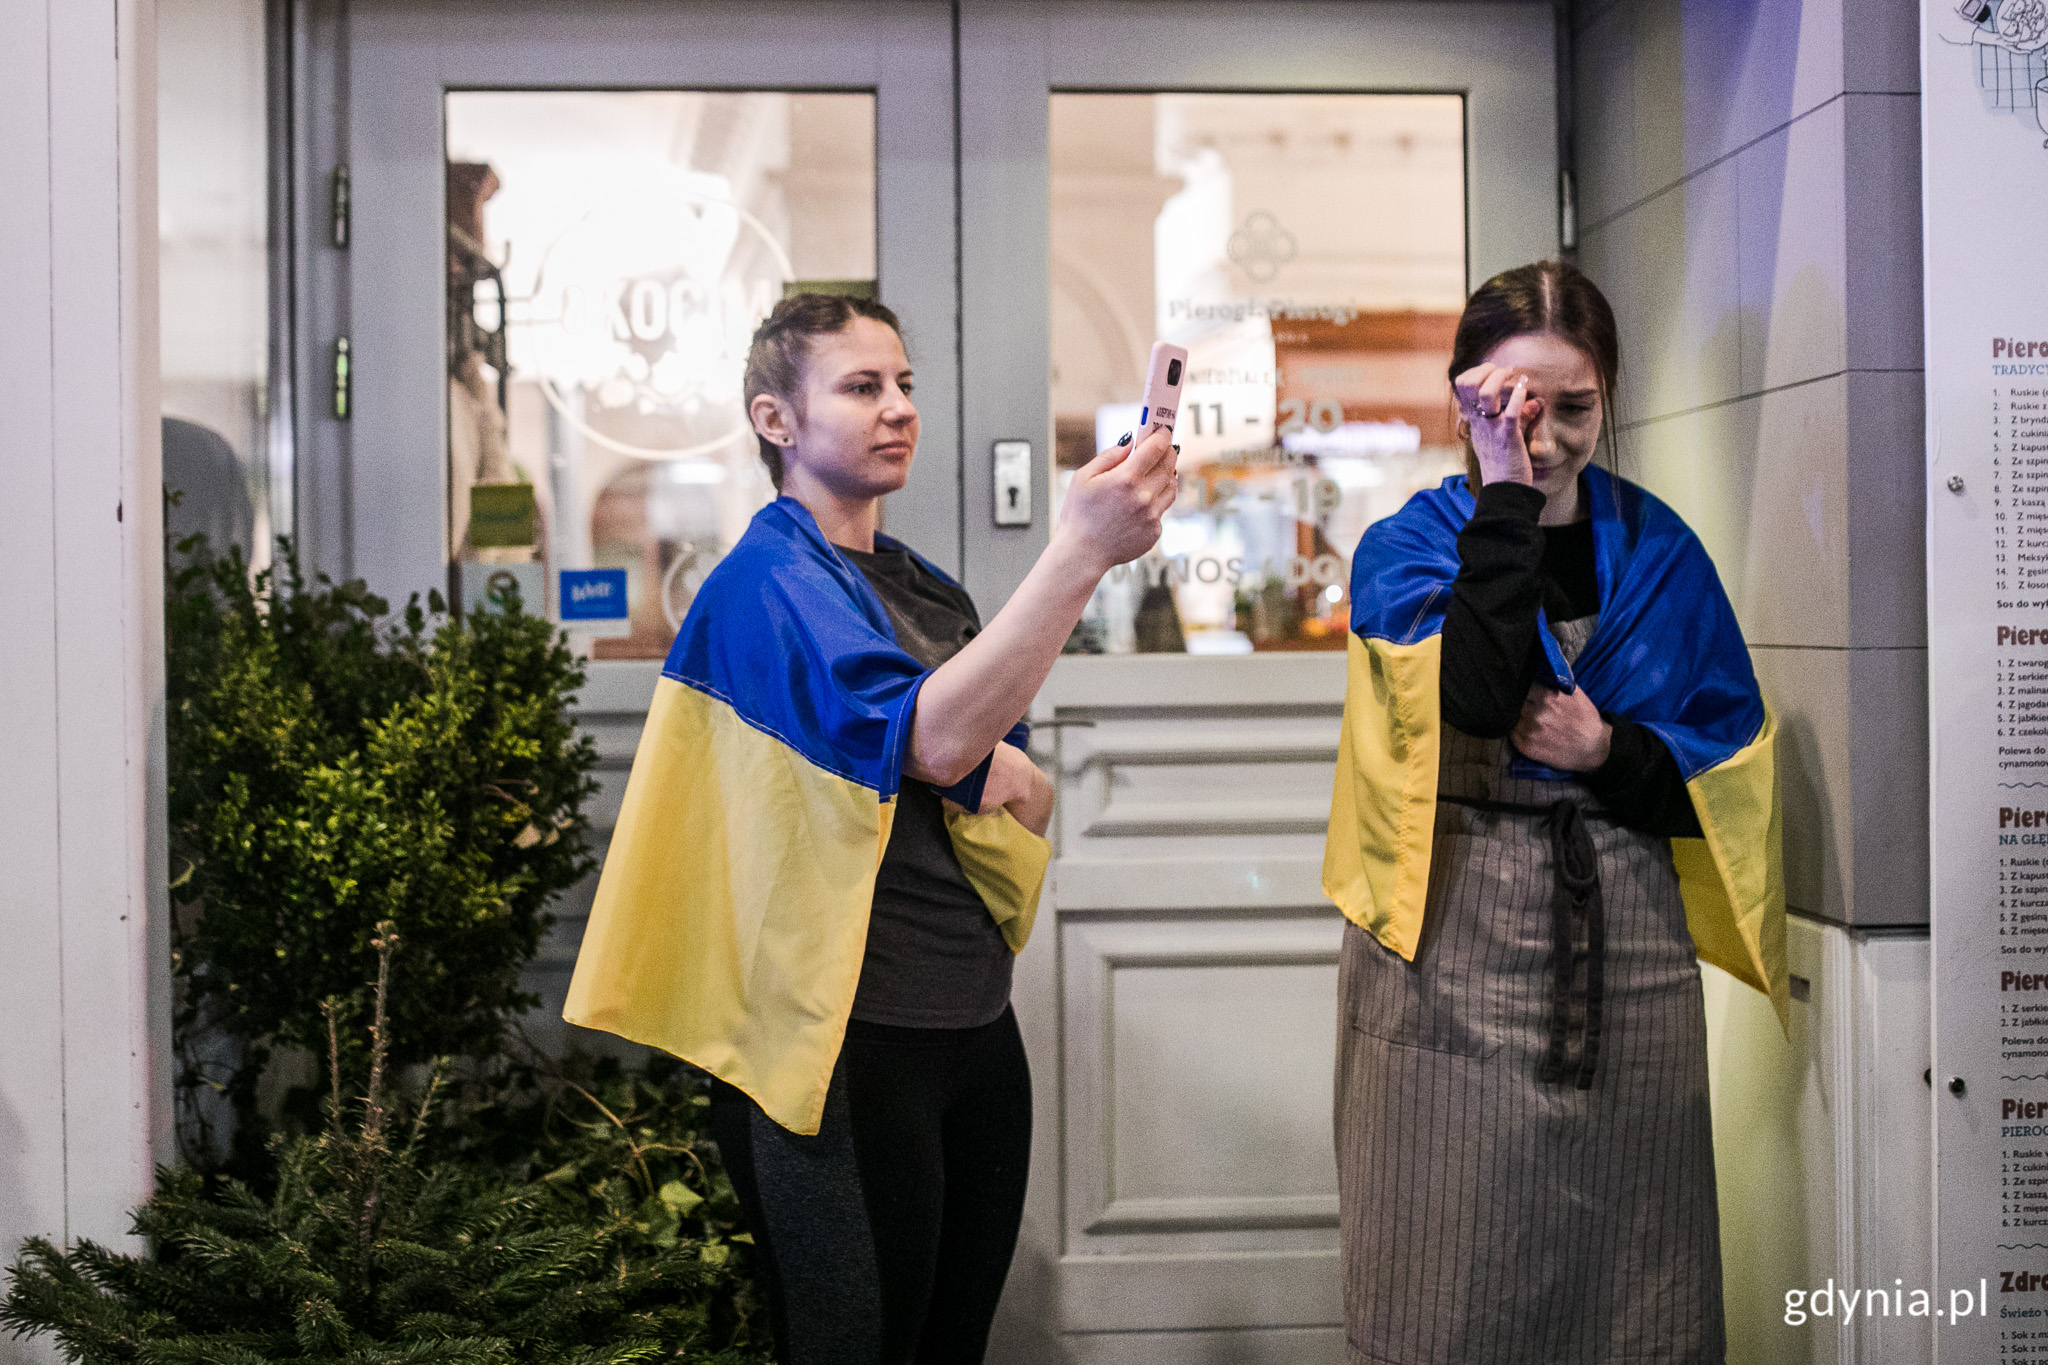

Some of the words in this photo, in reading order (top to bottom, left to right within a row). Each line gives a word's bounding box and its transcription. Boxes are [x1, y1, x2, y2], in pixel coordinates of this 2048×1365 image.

[1992, 364, 2048, 375] TRADYC
[2010, 387, 2040, 397] Ruskie
[2010, 401, 2040, 411] Ruskie
[1188, 403, 1225, 435] 11
[1277, 398, 1343, 435] 20
[2020, 415, 2048, 426] brynd
[2012, 457, 2023, 466] Ze
[2012, 470, 2023, 479] Ze
[2012, 484, 2024, 493] Ze
[1997, 600, 2014, 609] Sos
[2016, 600, 2030, 609] do
[2018, 673, 2048, 681] serkie
[2018, 686, 2048, 695] malina
[2018, 700, 2048, 711] jagoda
[2018, 714, 2048, 725] jabłkie
[1999, 746, 2032, 755] Polewa
[2034, 746, 2046, 754] do
[1999, 807, 2048, 828] Pier
[1999, 834, 2019, 846] NA
[2022, 833, 2048, 847] GŁĘ
[2010, 858, 2040, 867] Ruskie
[2010, 885, 2023, 894] Ze
[2001, 945, 2017, 954] Sos
[2019, 945, 2032, 954] do
[2034, 946, 2048, 955] wy
[2002, 1036, 2035, 1045] Polewa
[2013, 1150, 2043, 1159] Ruskie
[2013, 1177, 2026, 1186] Ze
[2000, 1304, 2042, 1319] Świeżo
[2011, 1331, 2029, 1340] Sok
[2011, 1345, 2028, 1353] Sok
